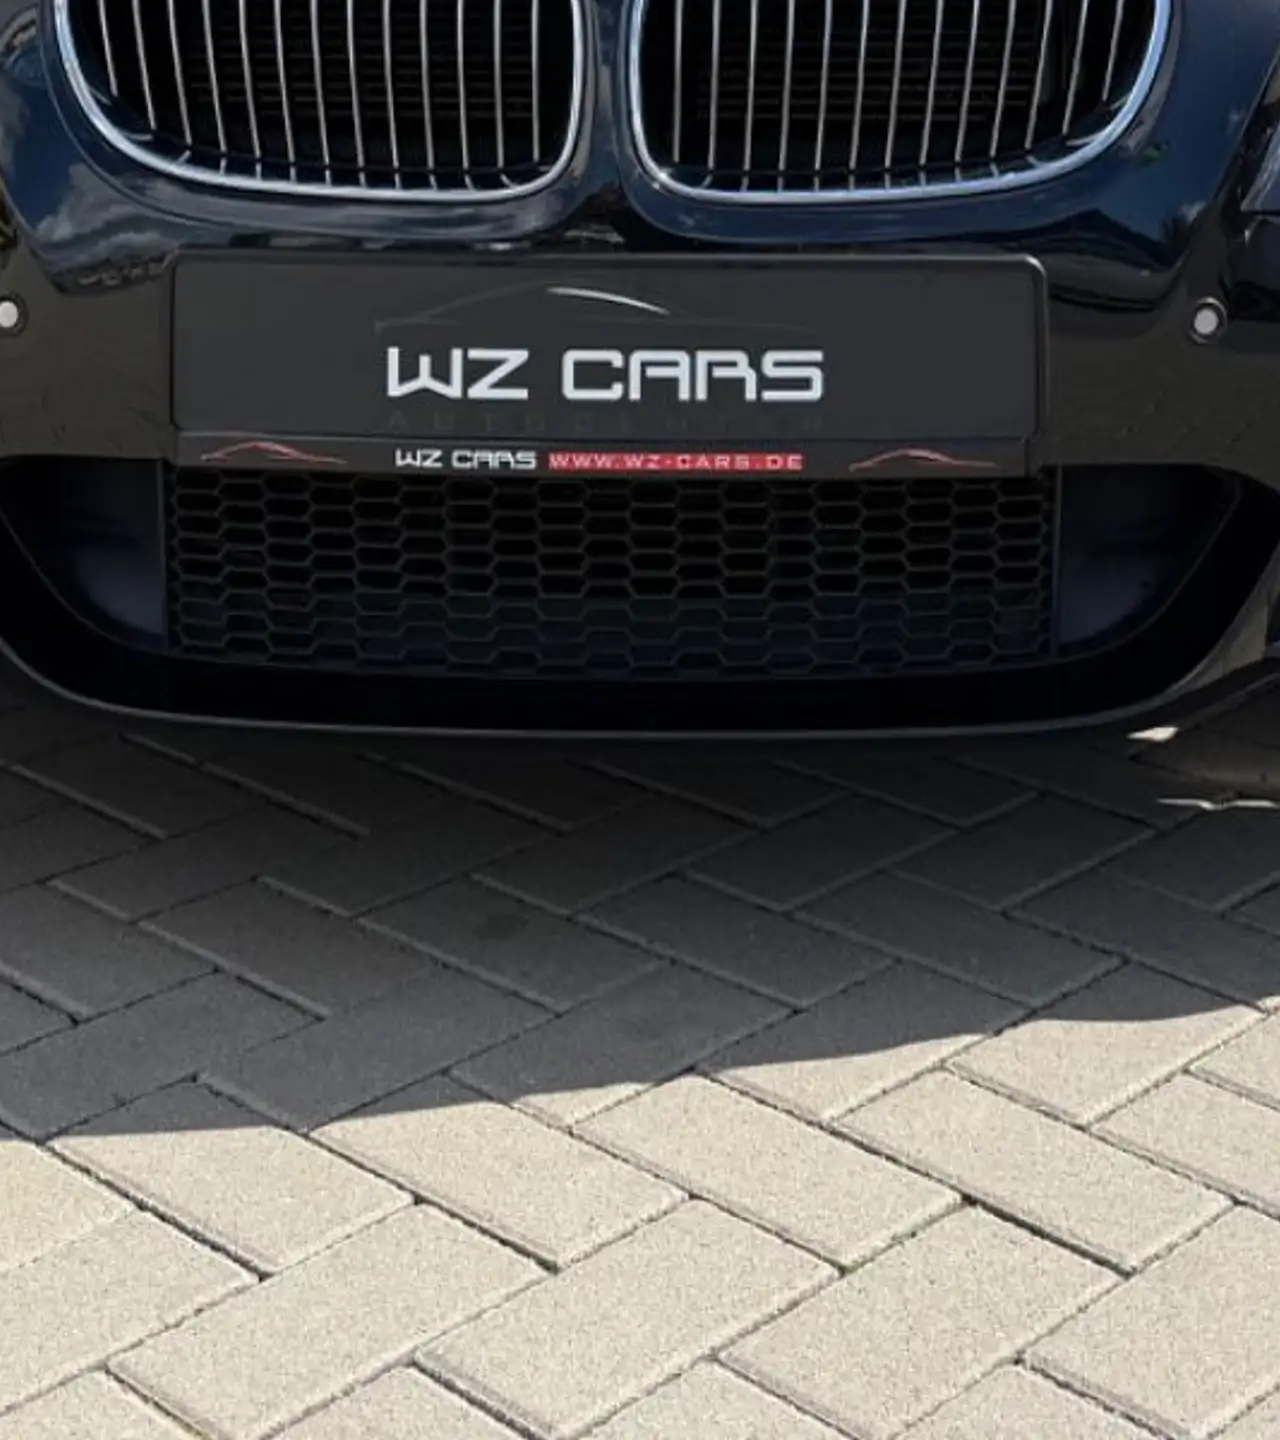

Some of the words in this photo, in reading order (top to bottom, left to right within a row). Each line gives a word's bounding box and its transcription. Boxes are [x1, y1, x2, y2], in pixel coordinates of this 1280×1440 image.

[387, 346, 529, 400] WZ
[562, 349, 824, 402] CARS
[394, 448, 443, 468] WZ
[451, 449, 537, 470] CARS
[548, 452, 804, 472] WWW.WZ-CARS.DE
